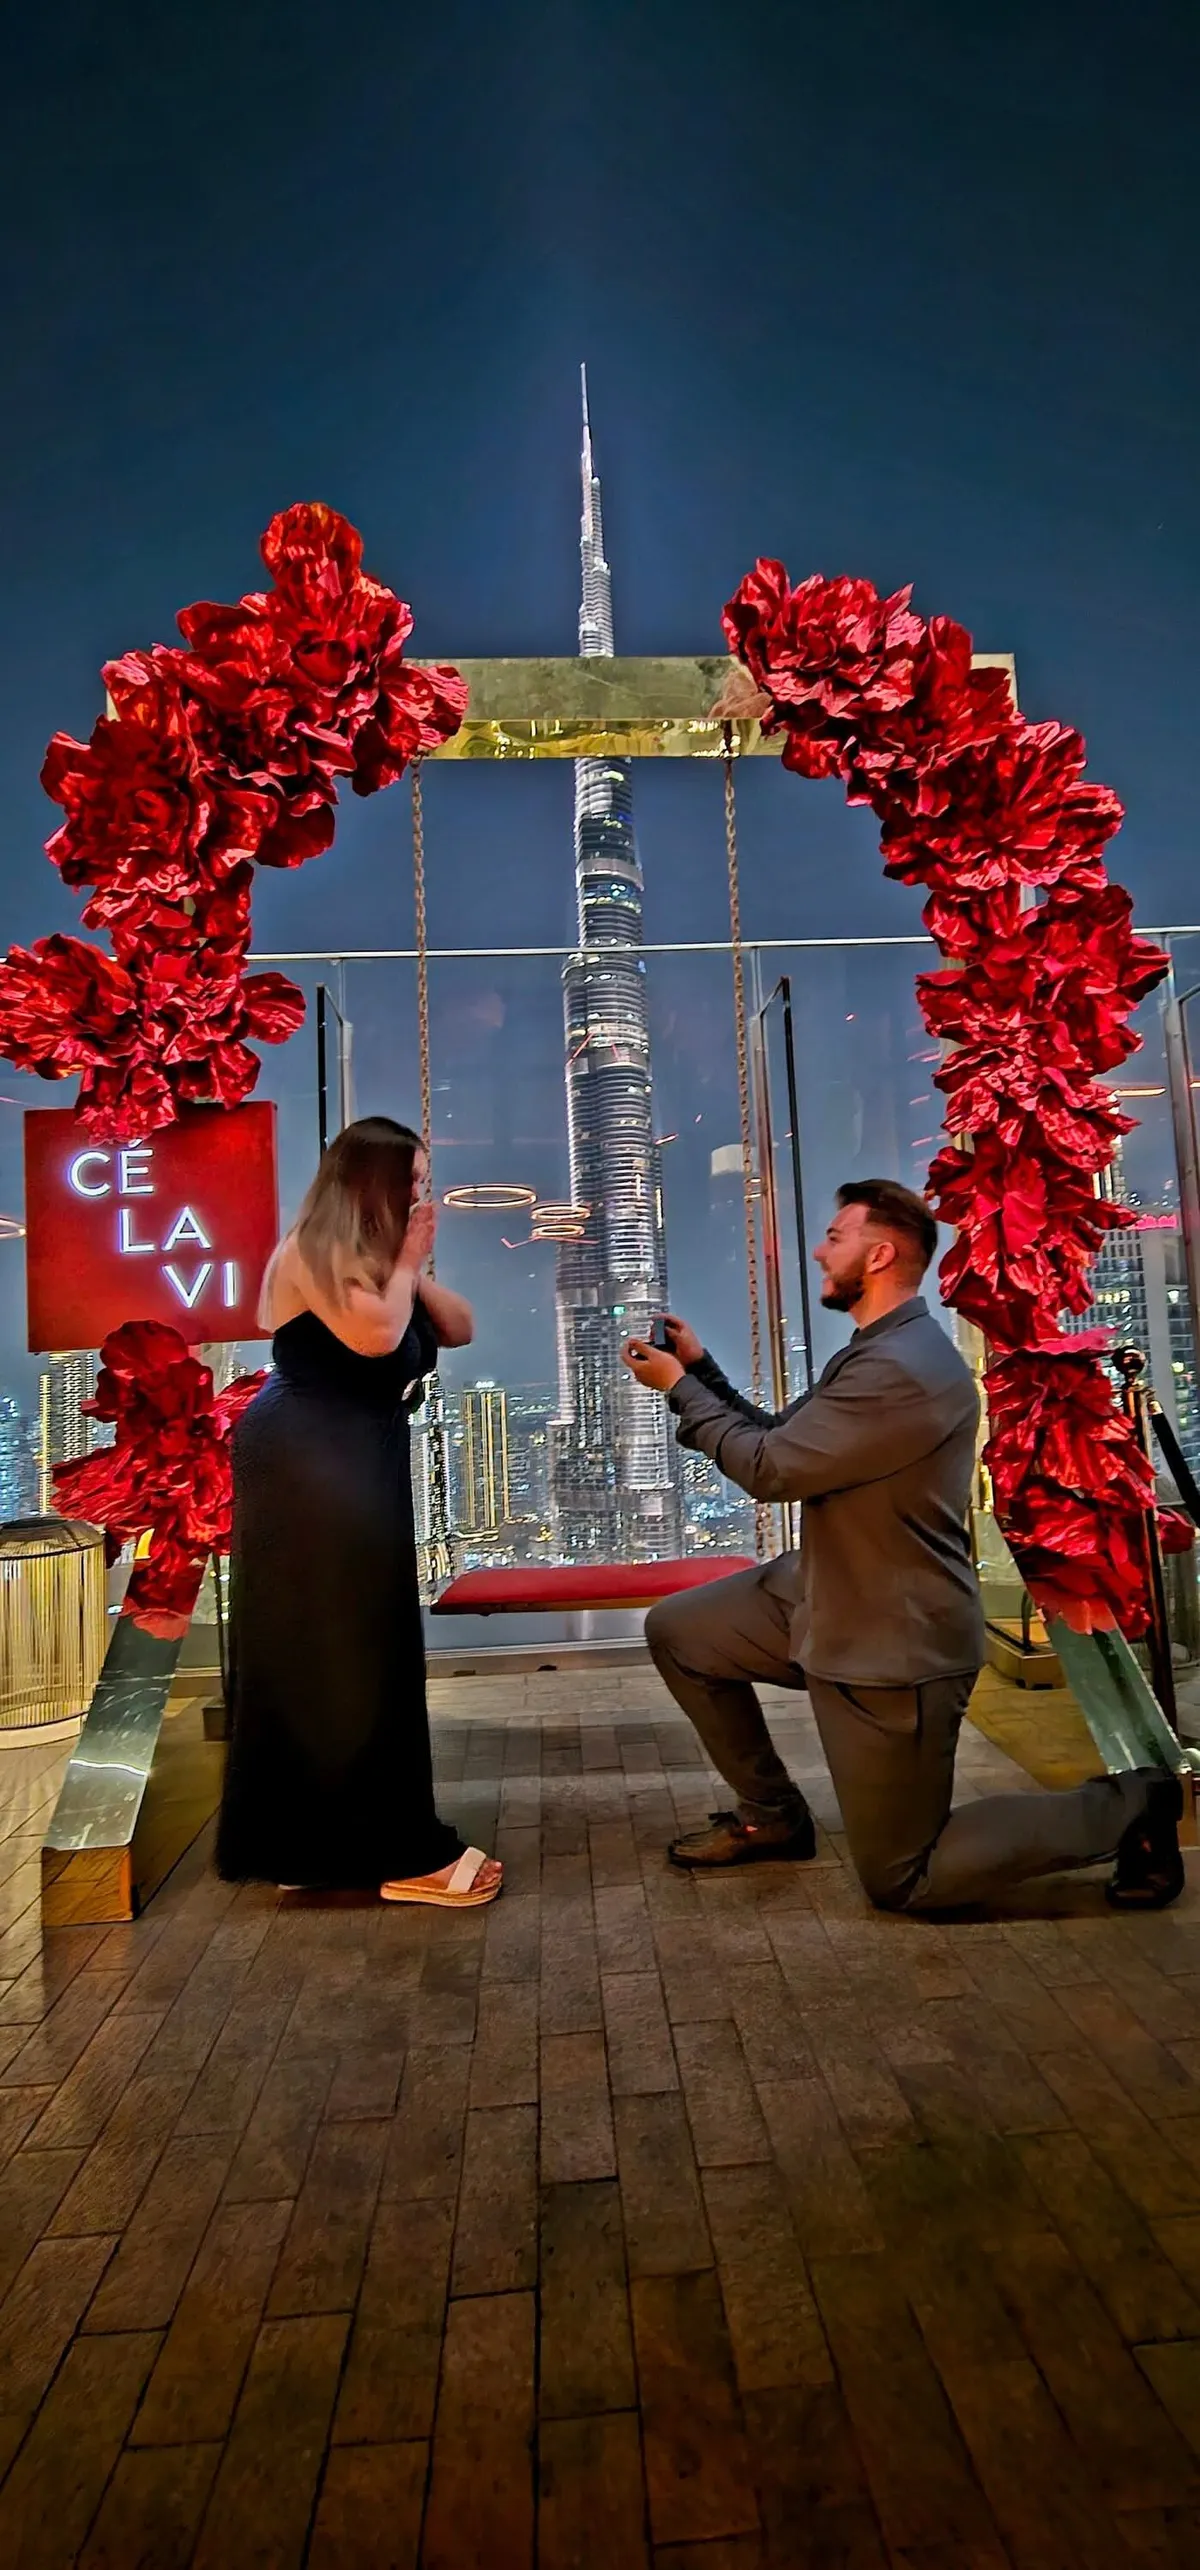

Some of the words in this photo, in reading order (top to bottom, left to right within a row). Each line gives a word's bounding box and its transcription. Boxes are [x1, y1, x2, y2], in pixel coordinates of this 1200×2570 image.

[68, 1138, 155, 1197] CÉ
[118, 1205, 213, 1254] LA
[161, 1261, 237, 1308] VI
